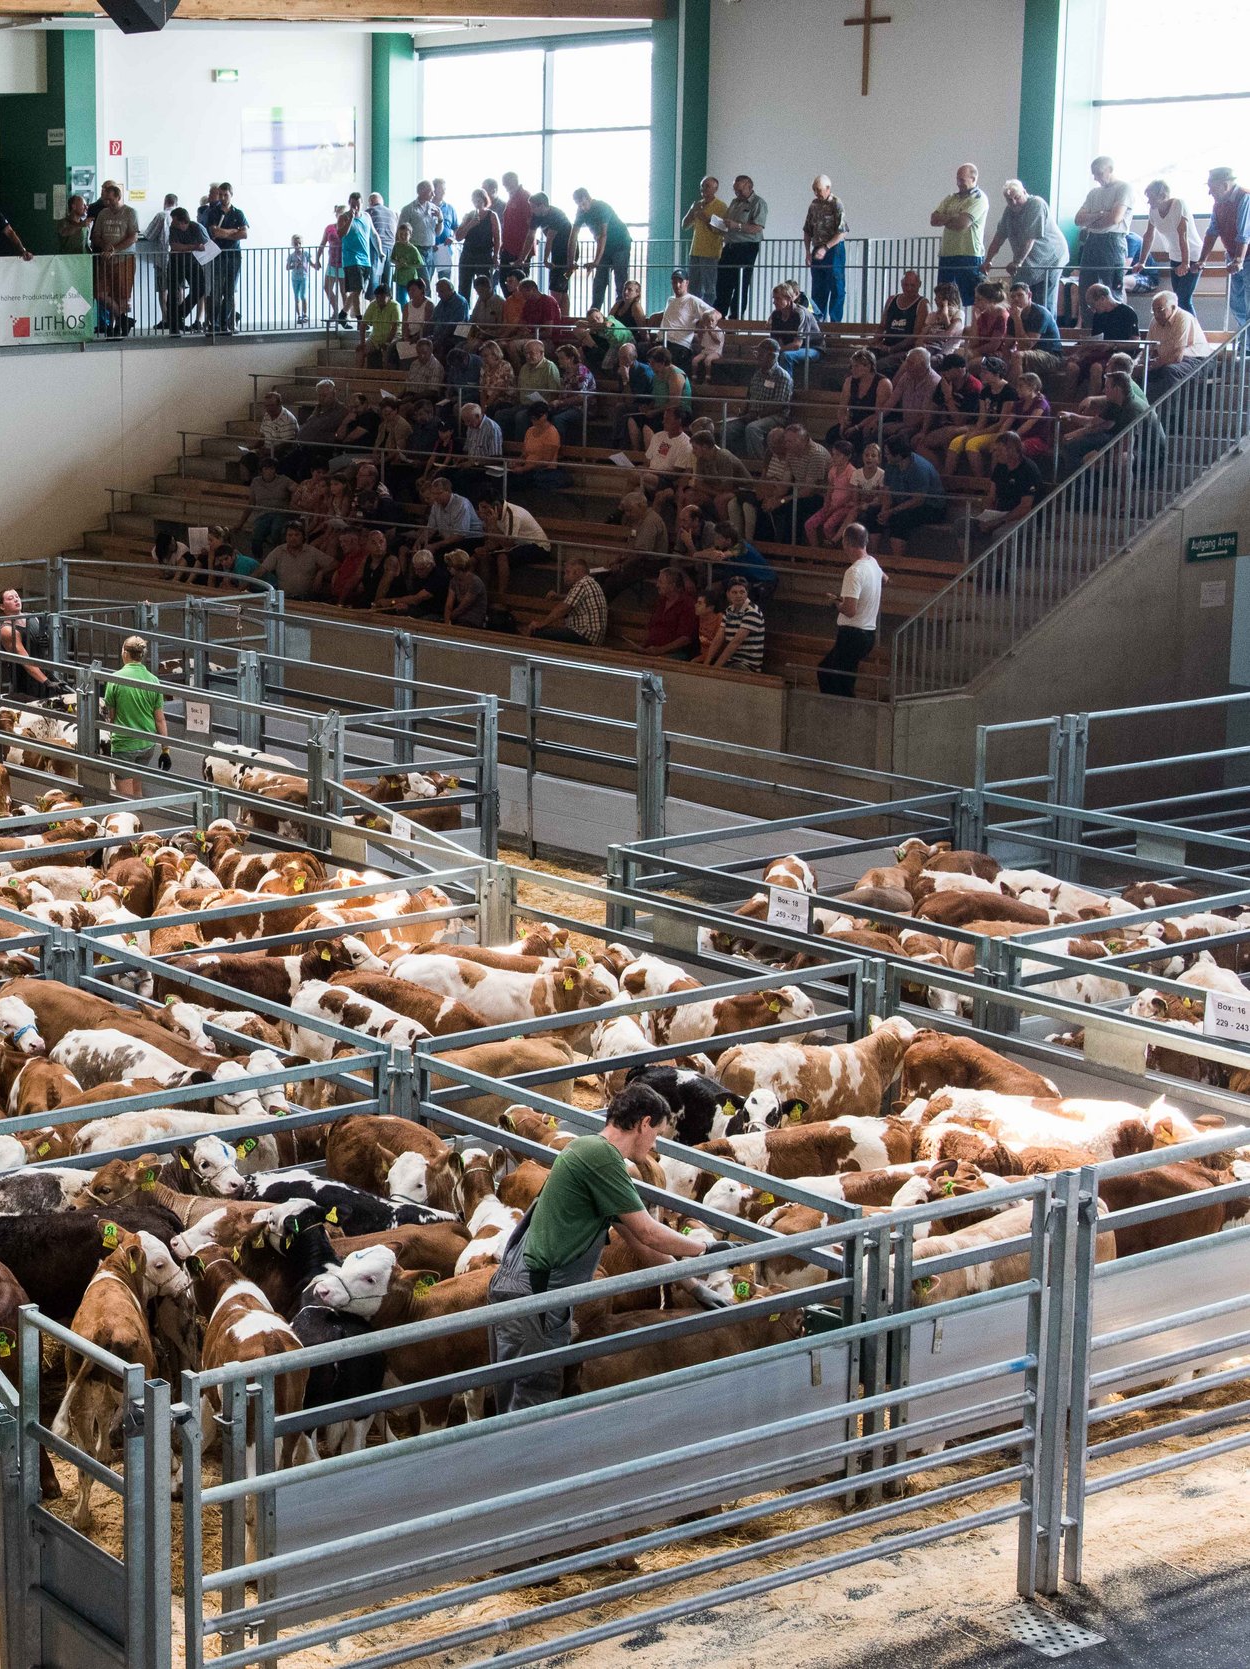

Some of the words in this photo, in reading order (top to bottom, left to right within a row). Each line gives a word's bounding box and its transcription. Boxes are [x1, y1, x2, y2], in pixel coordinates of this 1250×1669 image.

[34, 315, 85, 330] LITHOS
[1191, 539, 1216, 551] Aufgang
[1218, 536, 1235, 546] Arena
[777, 896, 790, 905] Box:
[1218, 1002, 1234, 1012] Box:
[1216, 1018, 1228, 1028] 229
[1236, 1022, 1249, 1032] 243
